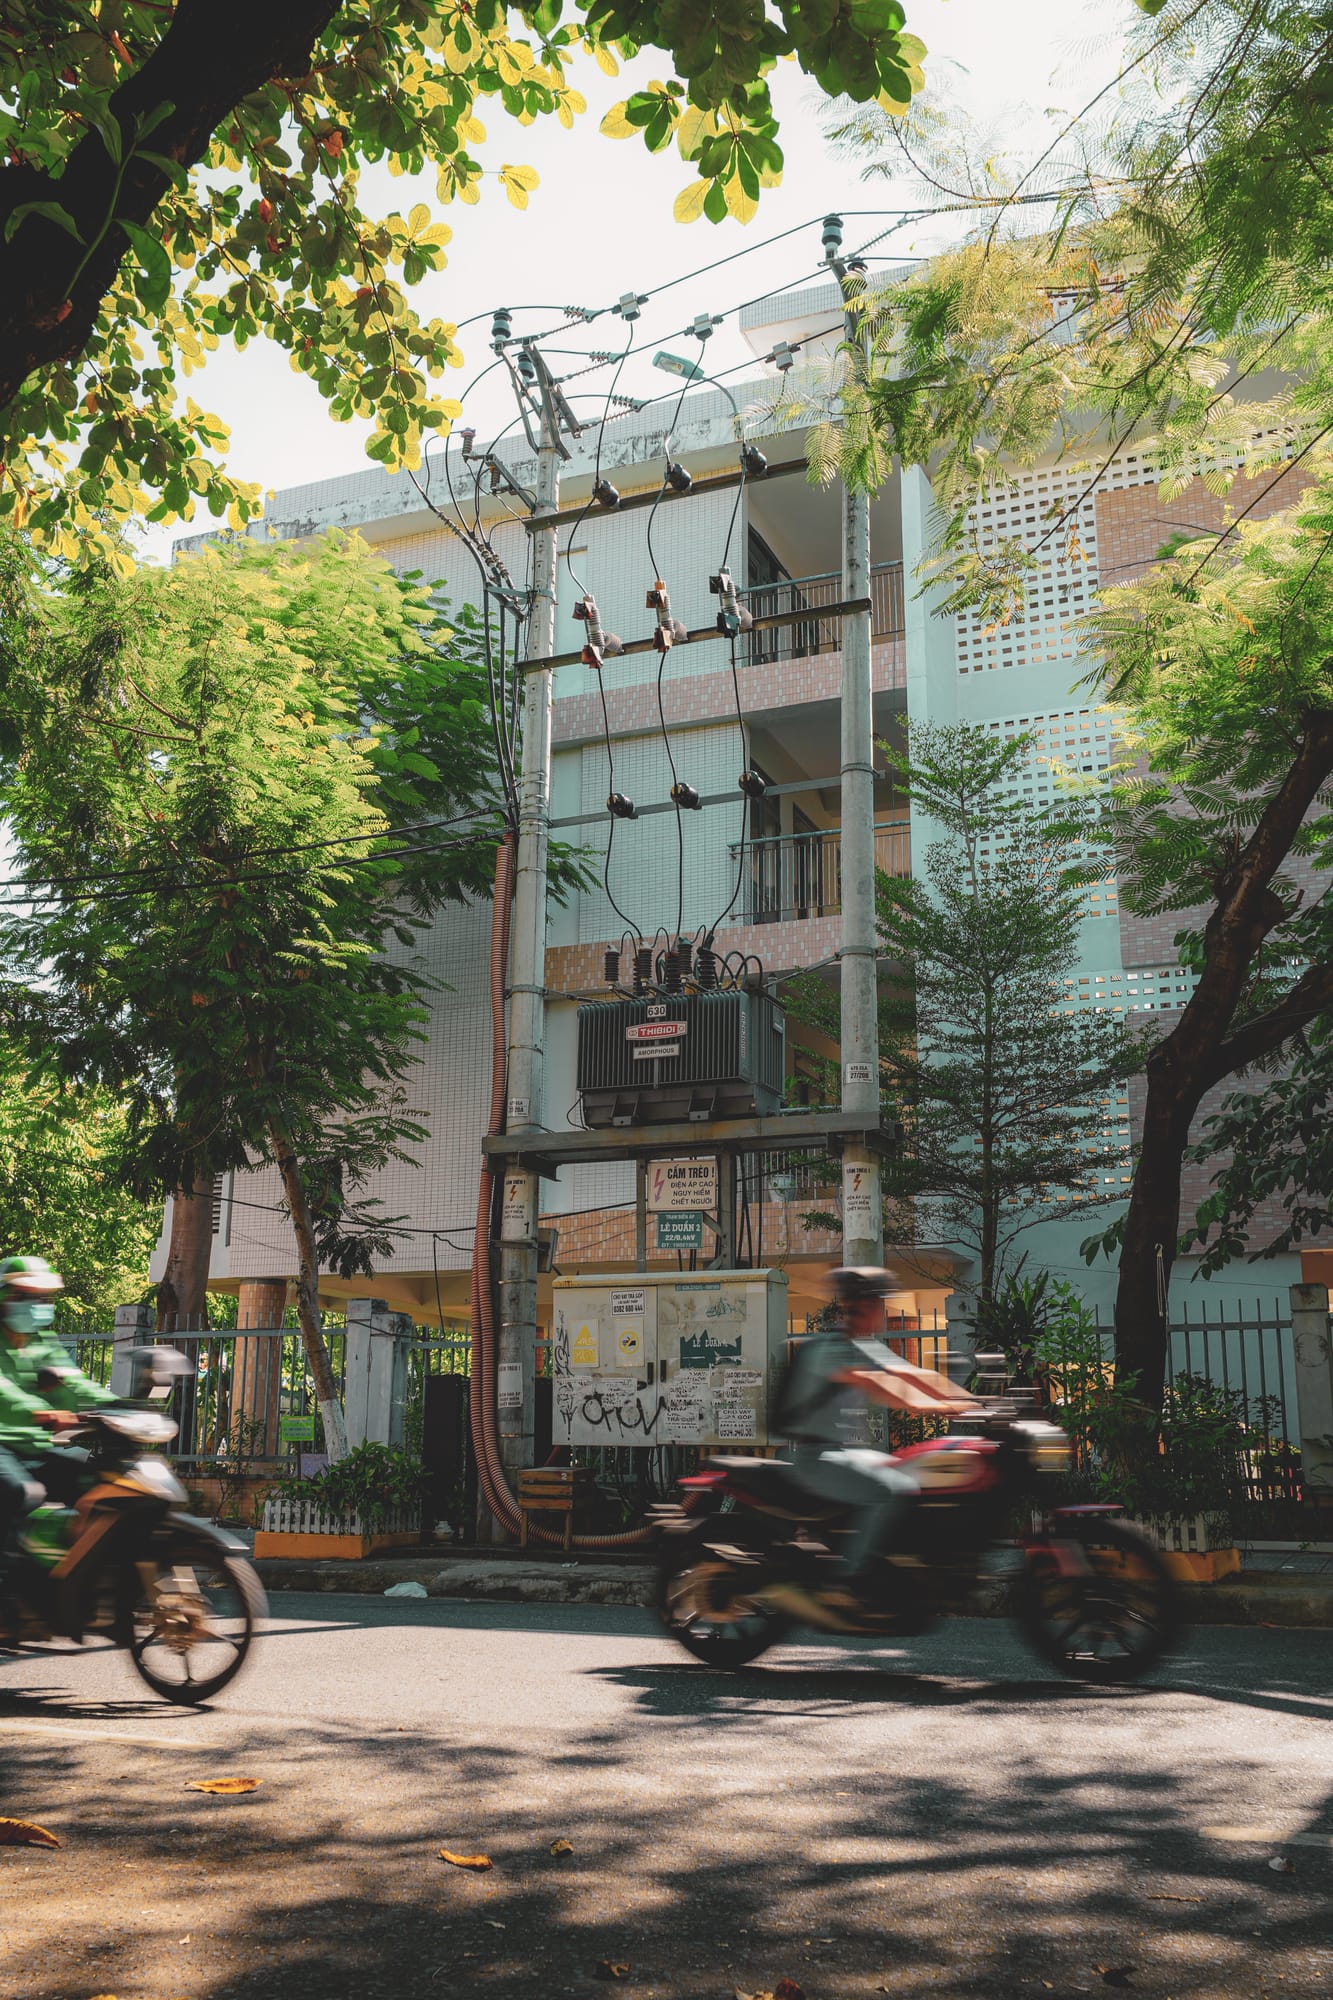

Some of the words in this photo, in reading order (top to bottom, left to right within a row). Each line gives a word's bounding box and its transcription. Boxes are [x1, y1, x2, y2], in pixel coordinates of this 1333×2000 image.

[648, 1006, 665, 1016] 630
[640, 1025, 676, 1036] THIBIDI
[638, 1047, 675, 1056] AMORPHOUS
[667, 1164, 686, 1179] CẤM
[670, 1181, 686, 1189] ĐIỆN
[688, 1180, 698, 1188] ÁP
[698, 1180, 714, 1188] CAO
[671, 1197, 689, 1205] CHẾT
[524, 1222, 530, 1234] 1
[695, 1224, 701, 1232] 2
